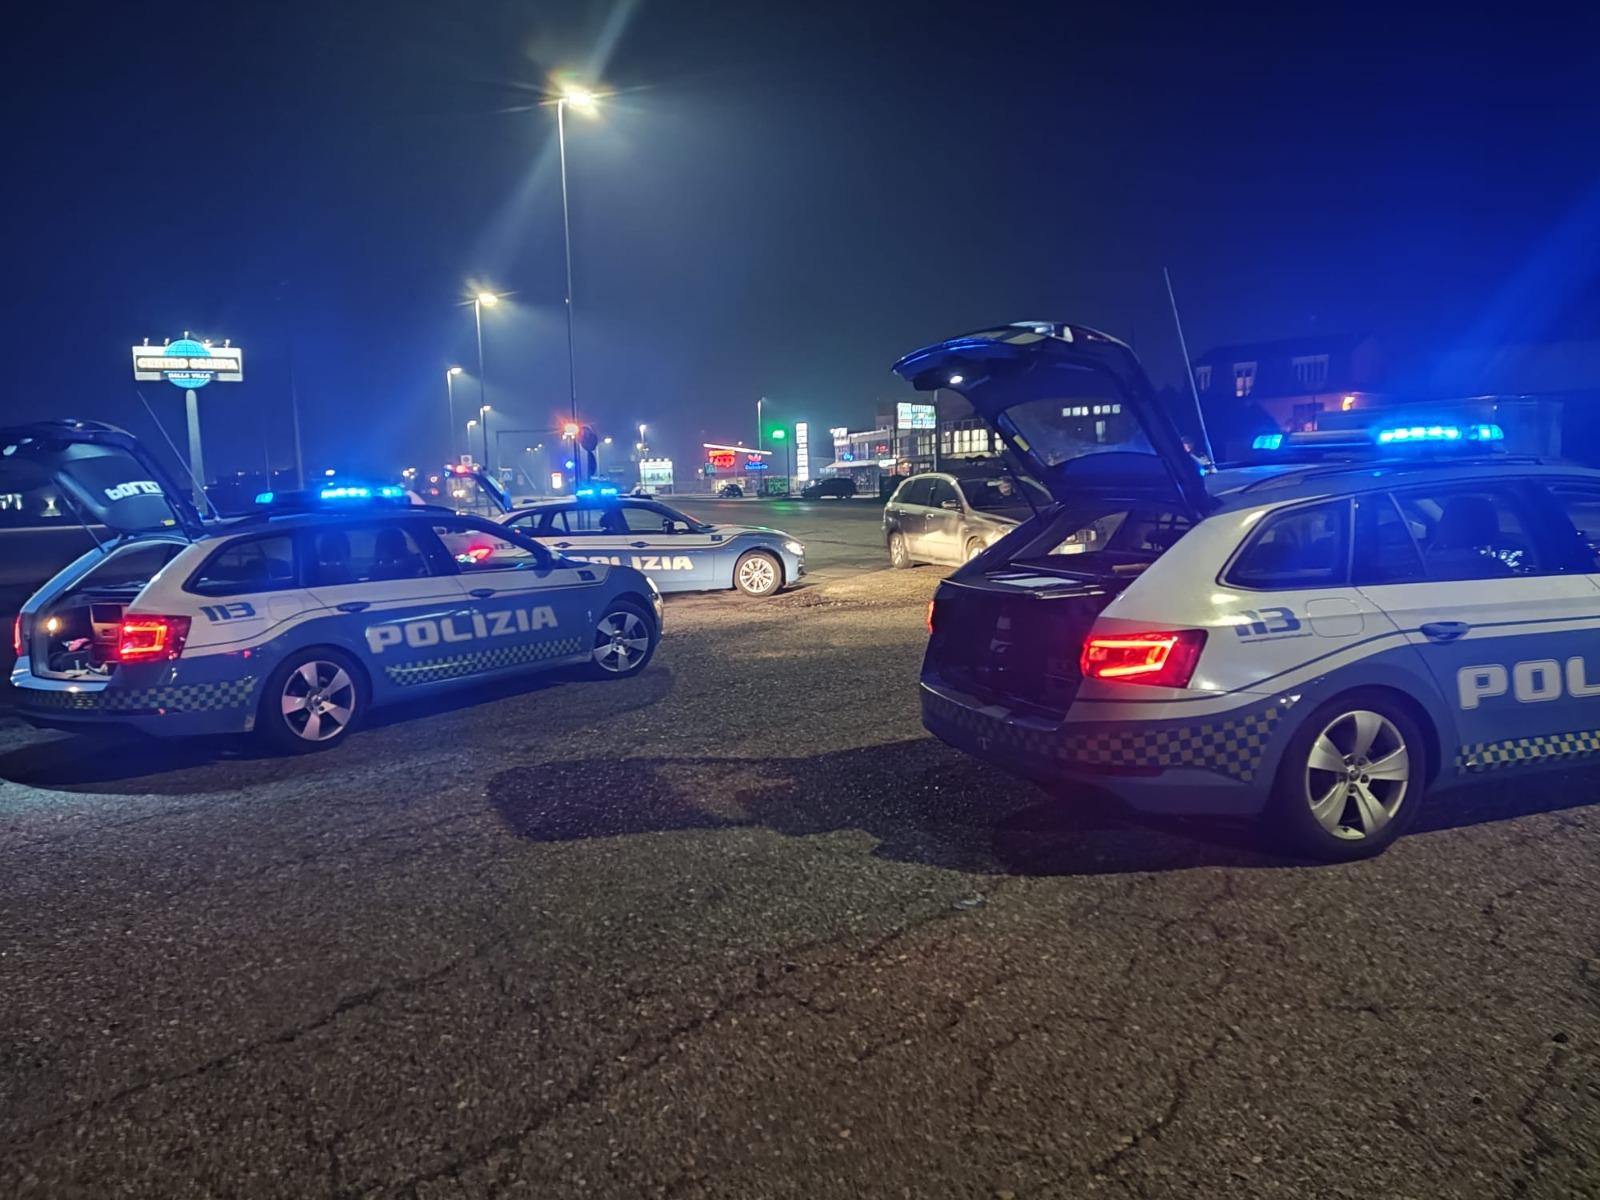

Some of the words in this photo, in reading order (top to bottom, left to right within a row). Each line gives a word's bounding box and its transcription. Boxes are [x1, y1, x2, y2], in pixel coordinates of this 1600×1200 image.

[199, 602, 256, 621] 113
[365, 606, 558, 654] POLIZIA
[1233, 607, 1301, 636] 113
[1457, 656, 1600, 710] POL
